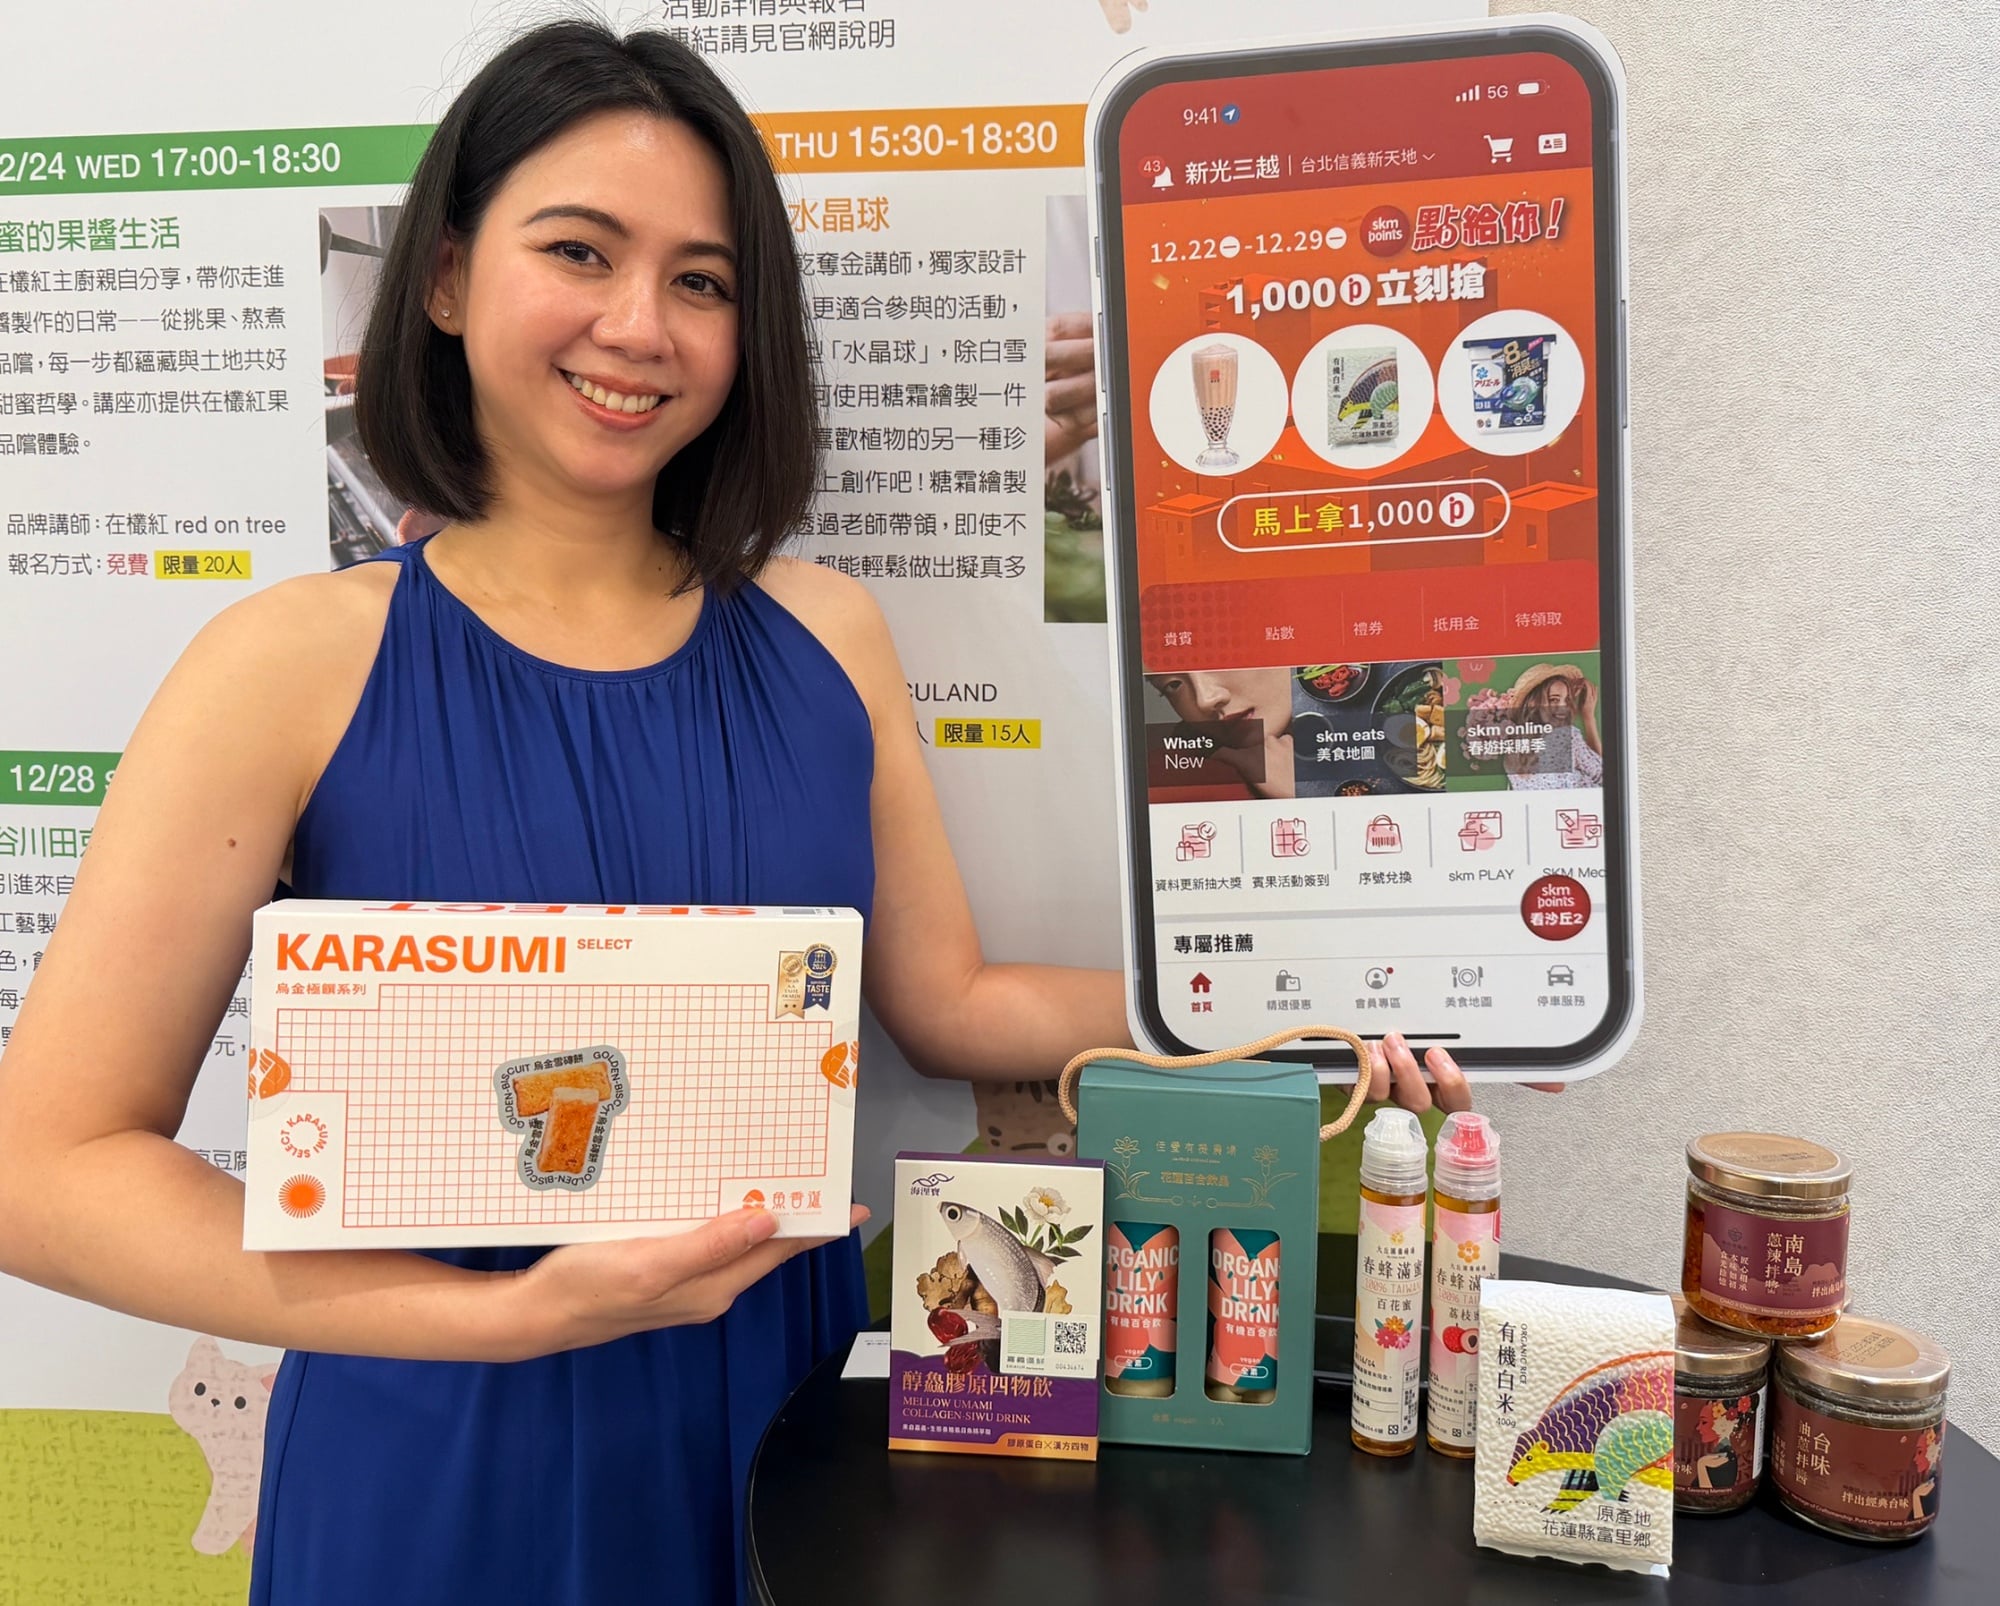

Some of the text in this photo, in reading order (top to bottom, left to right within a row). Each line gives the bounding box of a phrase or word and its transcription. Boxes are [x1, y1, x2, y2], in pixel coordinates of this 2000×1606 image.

[1487, 84, 1509, 100] 5G
[1182, 106, 1218, 126] 9:41
[775, 121, 1058, 159] THU 15:30-18:30
[0, 142, 341, 182] 2/24 WED 17:00-18:30
[1143, 159, 1162, 174] 43
[1184, 147, 1418, 187] 新光三越 台北信義新天地
[787, 196, 890, 233] 水晶球
[1372, 216, 1399, 230] skm
[0, 216, 180, 254] 蜜的果醬生活
[1367, 227, 1403, 244] points
[1225, 261, 1487, 321] 1,000 立刻搶
[174, 516, 207, 534] red
[215, 520, 239, 534] on
[245, 517, 287, 535] tree
[1433, 616, 1480, 633] 抵用金
[1515, 611, 1563, 628] 待領取
[1265, 625, 1295, 642] 點數
[1353, 621, 1383, 637] 禮券
[1163, 631, 1192, 647] 貴賓
[1316, 728, 1385, 744] skm eats
[1467, 720, 1553, 737] skm online
[1316, 746, 1376, 762] 美食地圖
[1467, 738, 1547, 755] 春遊採購季
[1164, 753, 1205, 769] New
[10, 764, 96, 793] 12/28
[1155, 876, 1242, 892] 資料更新抽大獎
[1252, 873, 1330, 889] 賓果活動簽到
[1358, 870, 1412, 886] 序號兌換
[1448, 868, 1515, 883] skm PLAY
[1541, 884, 1571, 897] skm
[1537, 896, 1576, 909] points
[1530, 911, 1584, 927] 看沙丘2
[1173, 933, 1254, 955] 專屬推薦
[277, 933, 566, 973] KARASUMI
[577, 938, 633, 950] SELECT
[806, 984, 831, 993] TASTE
[1191, 1001, 1213, 1013] 首頁
[1266, 999, 1312, 1011] 精選優惠
[1355, 997, 1401, 1009] 會員專區
[1445, 995, 1492, 1009] 美食地圖
[1537, 994, 1586, 1008] 停車服務
[280, 1113, 329, 1158] KARASUMI SELECT
[1784, 1234, 1804, 1277] 南島
[1117, 1269, 1160, 1293] LILY
[1232, 1277, 1276, 1301] LILY
[1106, 1290, 1168, 1315] DRINK
[1376, 1298, 1413, 1312] 百花蜜
[1110, 1315, 1162, 1329] 有機百合飲
[1519, 1323, 1528, 1386] ORGANIC RICE
[1496, 1320, 1517, 1415] 有機白米
[903, 1396, 993, 1411] MELLOW UMAMI
[903, 1407, 1032, 1425] COLLAGEN-SIWU DRINK
[1811, 1432, 1831, 1476] 台味
[1597, 1504, 1651, 1528] 原產地
[1542, 1519, 1651, 1548] 花蓮縣富里鄉
